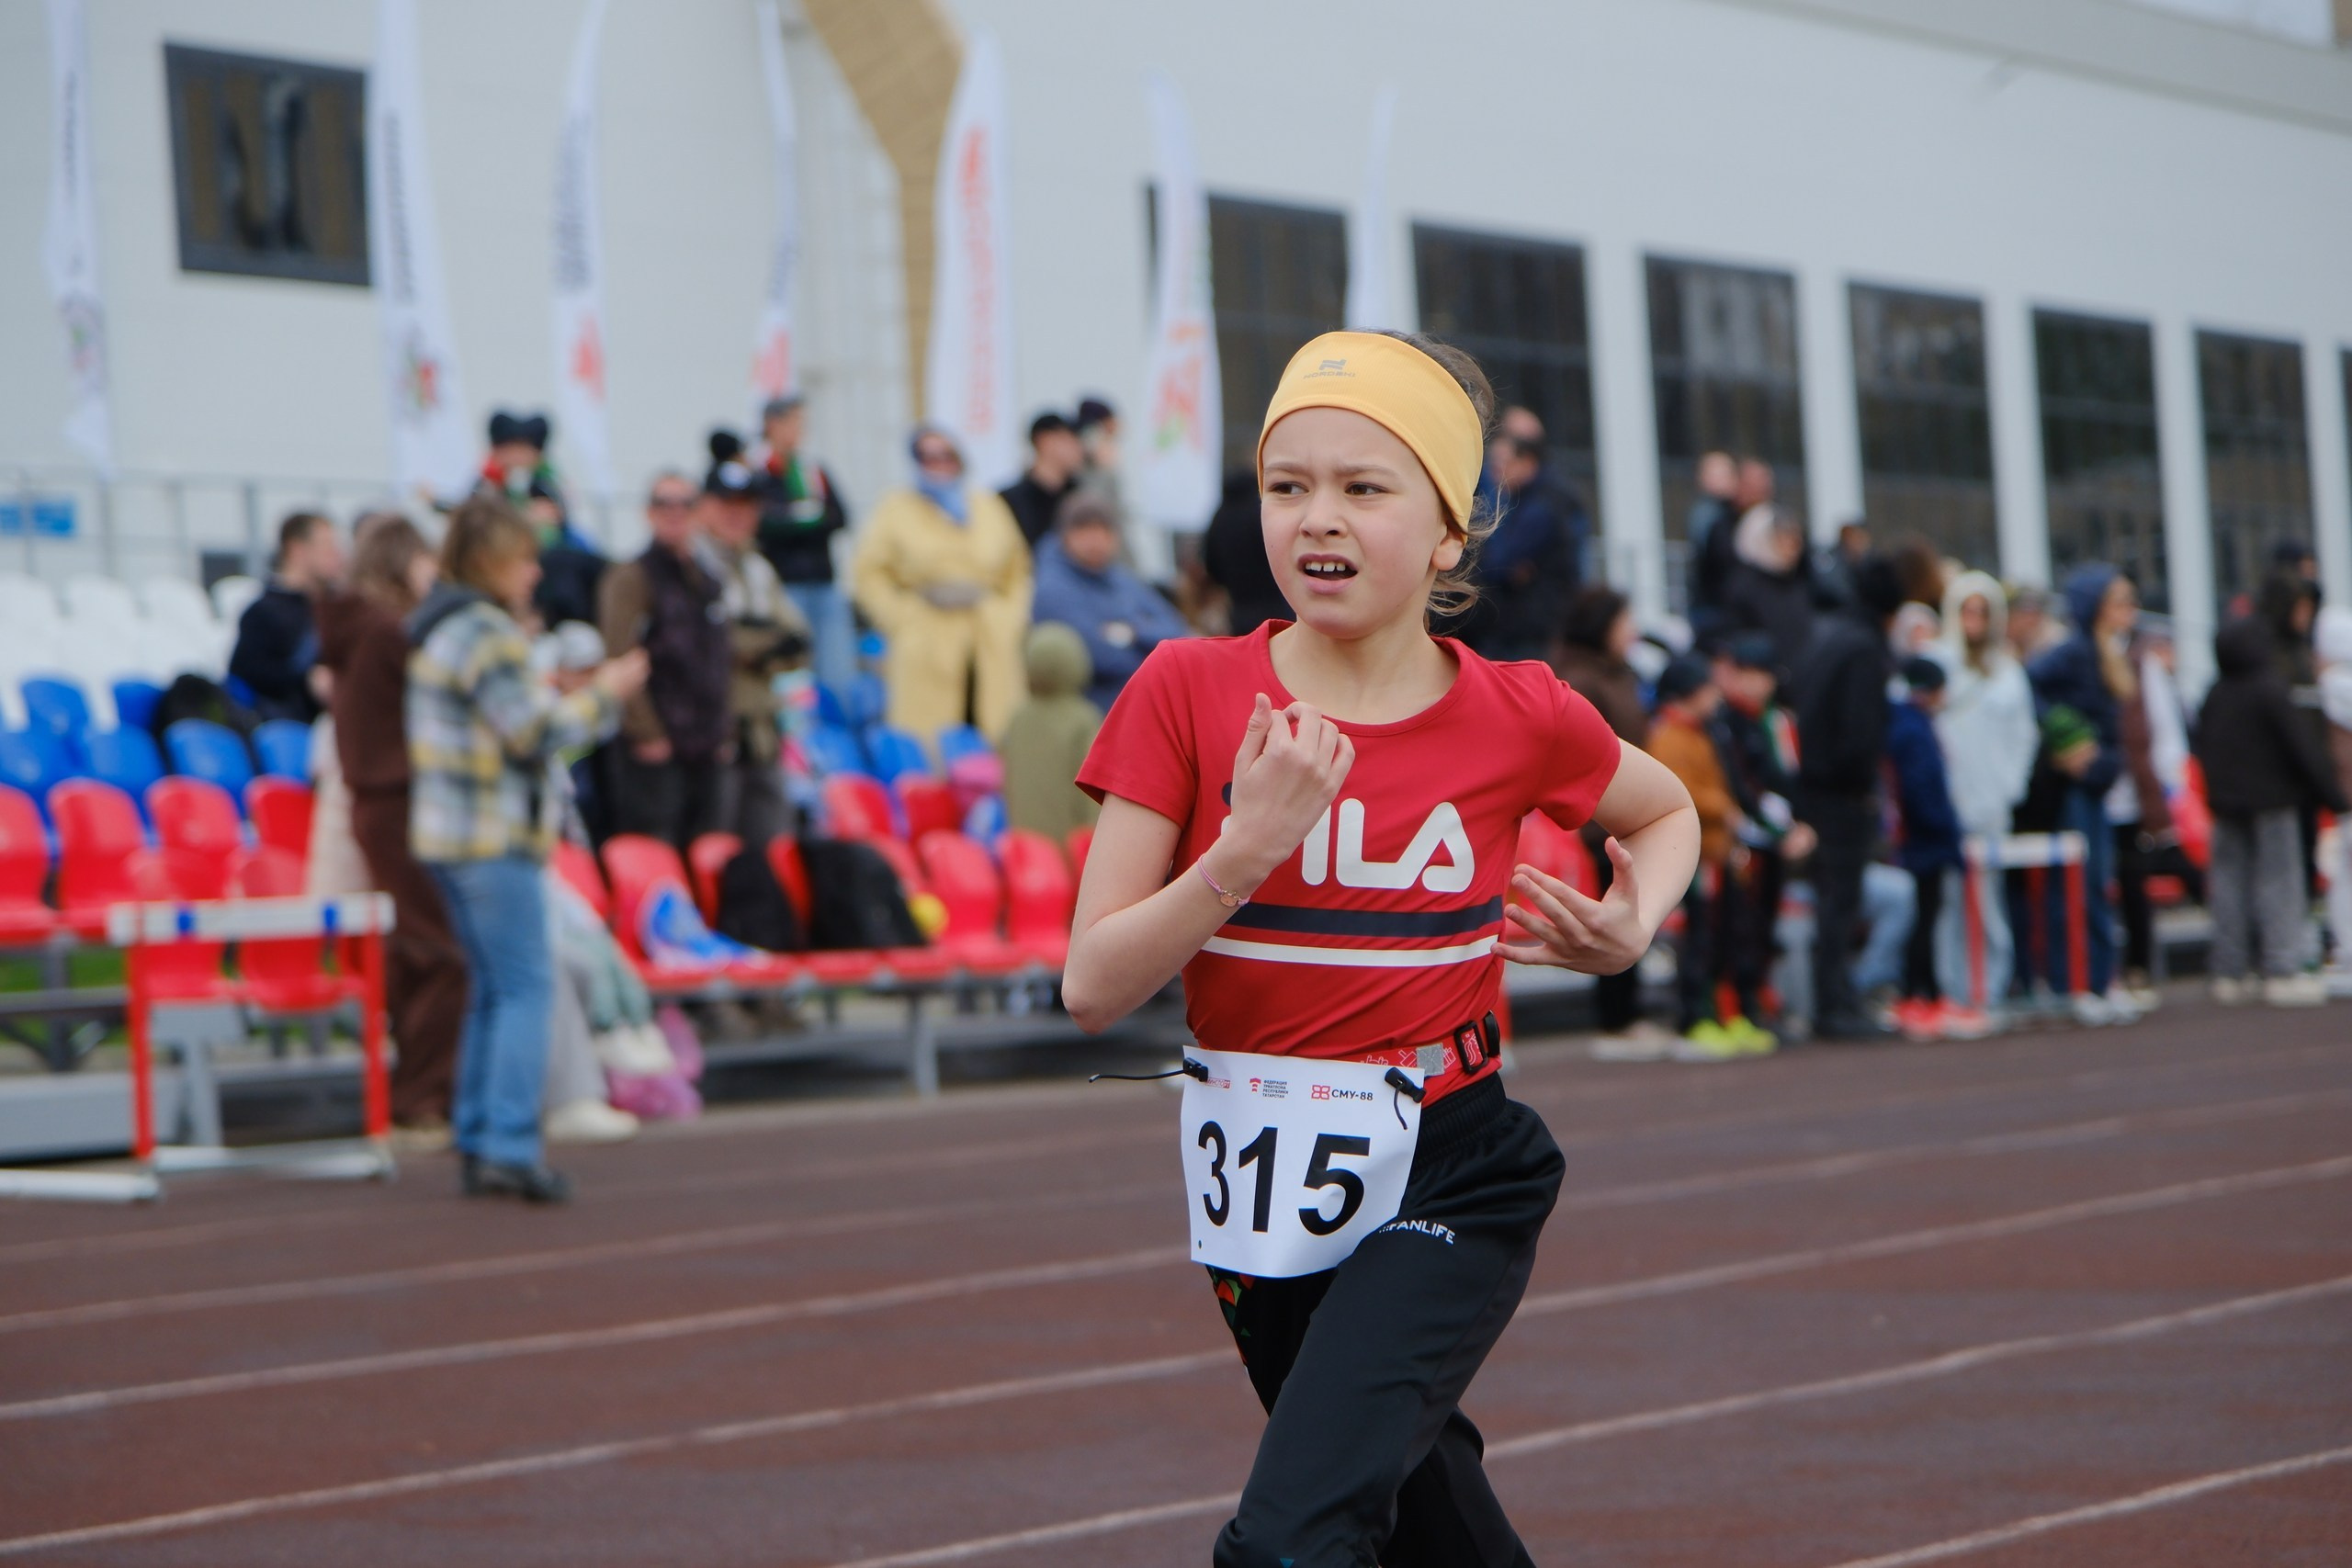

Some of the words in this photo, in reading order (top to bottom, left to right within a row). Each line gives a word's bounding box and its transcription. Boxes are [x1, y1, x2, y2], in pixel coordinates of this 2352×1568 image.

[1221, 797, 1475, 893] ILA
[1331, 1089, 1374, 1101] СМУ-88
[1197, 1120, 1371, 1236] 315
